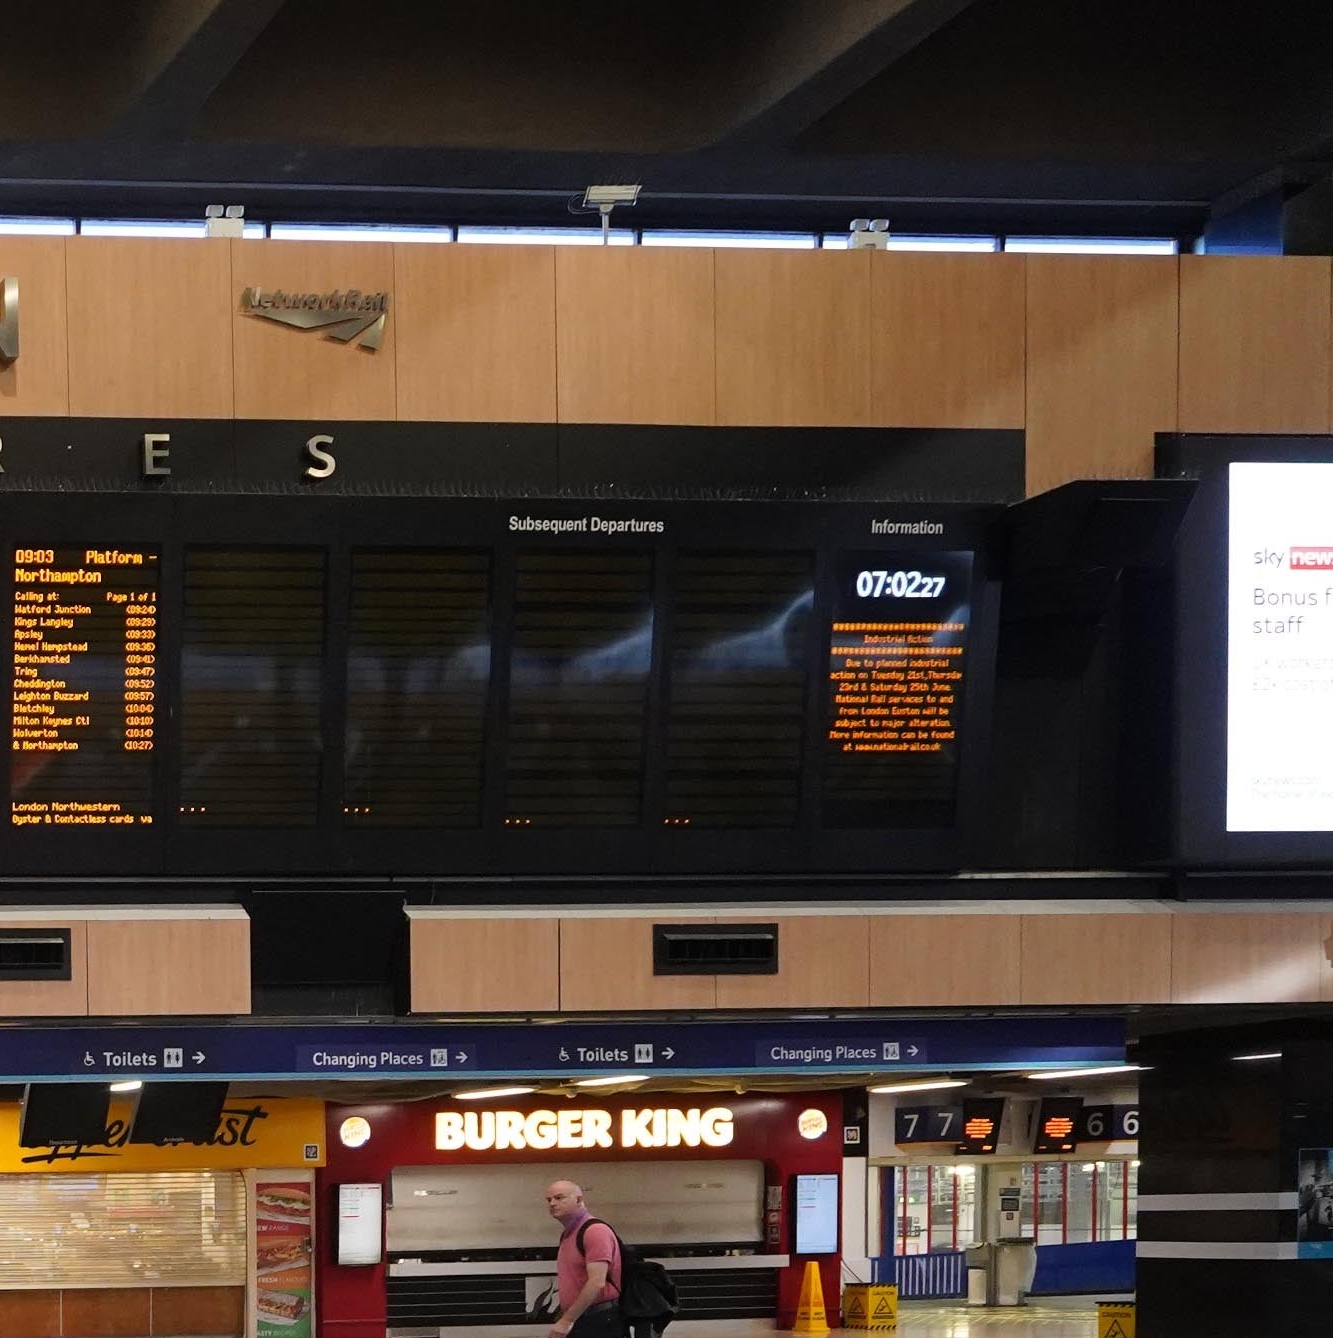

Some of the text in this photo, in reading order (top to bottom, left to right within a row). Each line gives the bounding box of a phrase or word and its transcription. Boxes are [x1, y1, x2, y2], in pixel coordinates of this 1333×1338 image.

[509, 517, 664, 535] Subsequent Departures
[872, 520, 943, 535] Information
[16, 550, 142, 564] 09:03 Platform
[1254, 548, 1284, 568] sky
[15, 569, 101, 584] Northampton
[1254, 588, 1317, 605] Bonus
[1253, 616, 1304, 633] staff
[103, 1050, 156, 1067] Toilets
[312, 1050, 423, 1069] Changing Places
[577, 1046, 628, 1063] Toilets
[771, 1044, 877, 1062] Changing Places
[435, 1107, 733, 1150] BURGER KING
[904, 1114, 919, 1138] 7
[938, 1113, 954, 1136] 7
[1087, 1113, 1103, 1136] 6
[1122, 1111, 1139, 1134] 6
